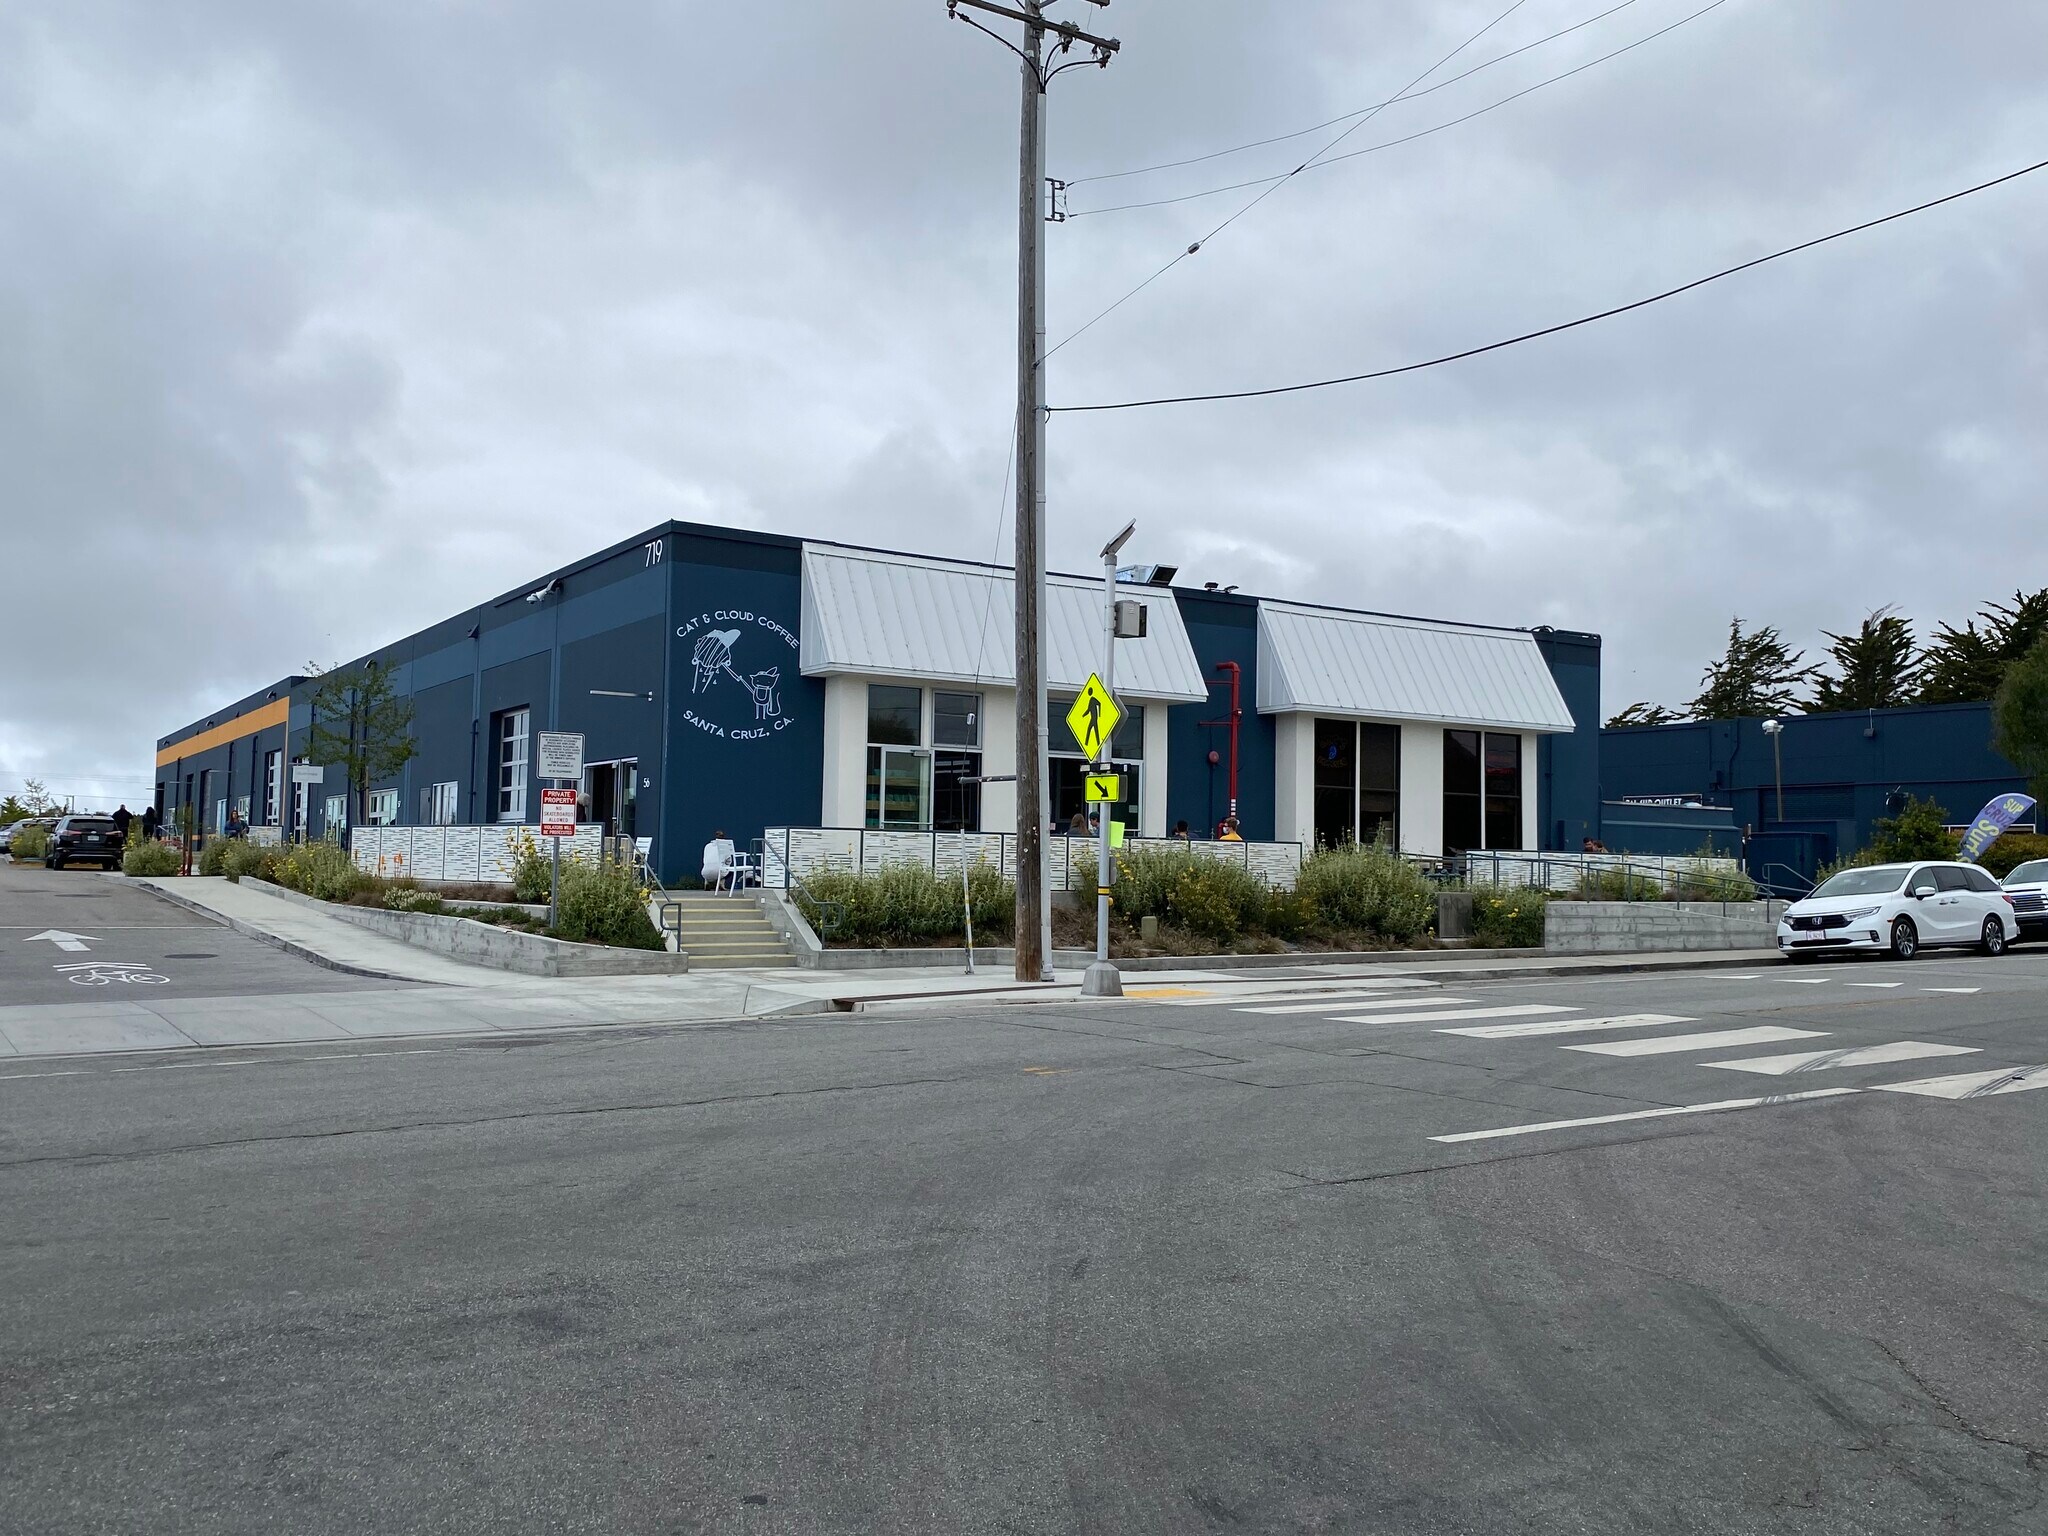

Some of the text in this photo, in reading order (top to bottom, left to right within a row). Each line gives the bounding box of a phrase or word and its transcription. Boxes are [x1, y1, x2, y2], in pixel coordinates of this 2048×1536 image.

[645, 539, 663, 568] 719
[676, 610, 800, 650] CAT & CLOUD COFFEE
[683, 710, 795, 740] SANTA CRUZ, CA.
[643, 777, 651, 788] 56
[1984, 804, 2016, 828] CRUZ
[2003, 798, 2025, 815] SUP
[1964, 819, 2000, 857] Surf
